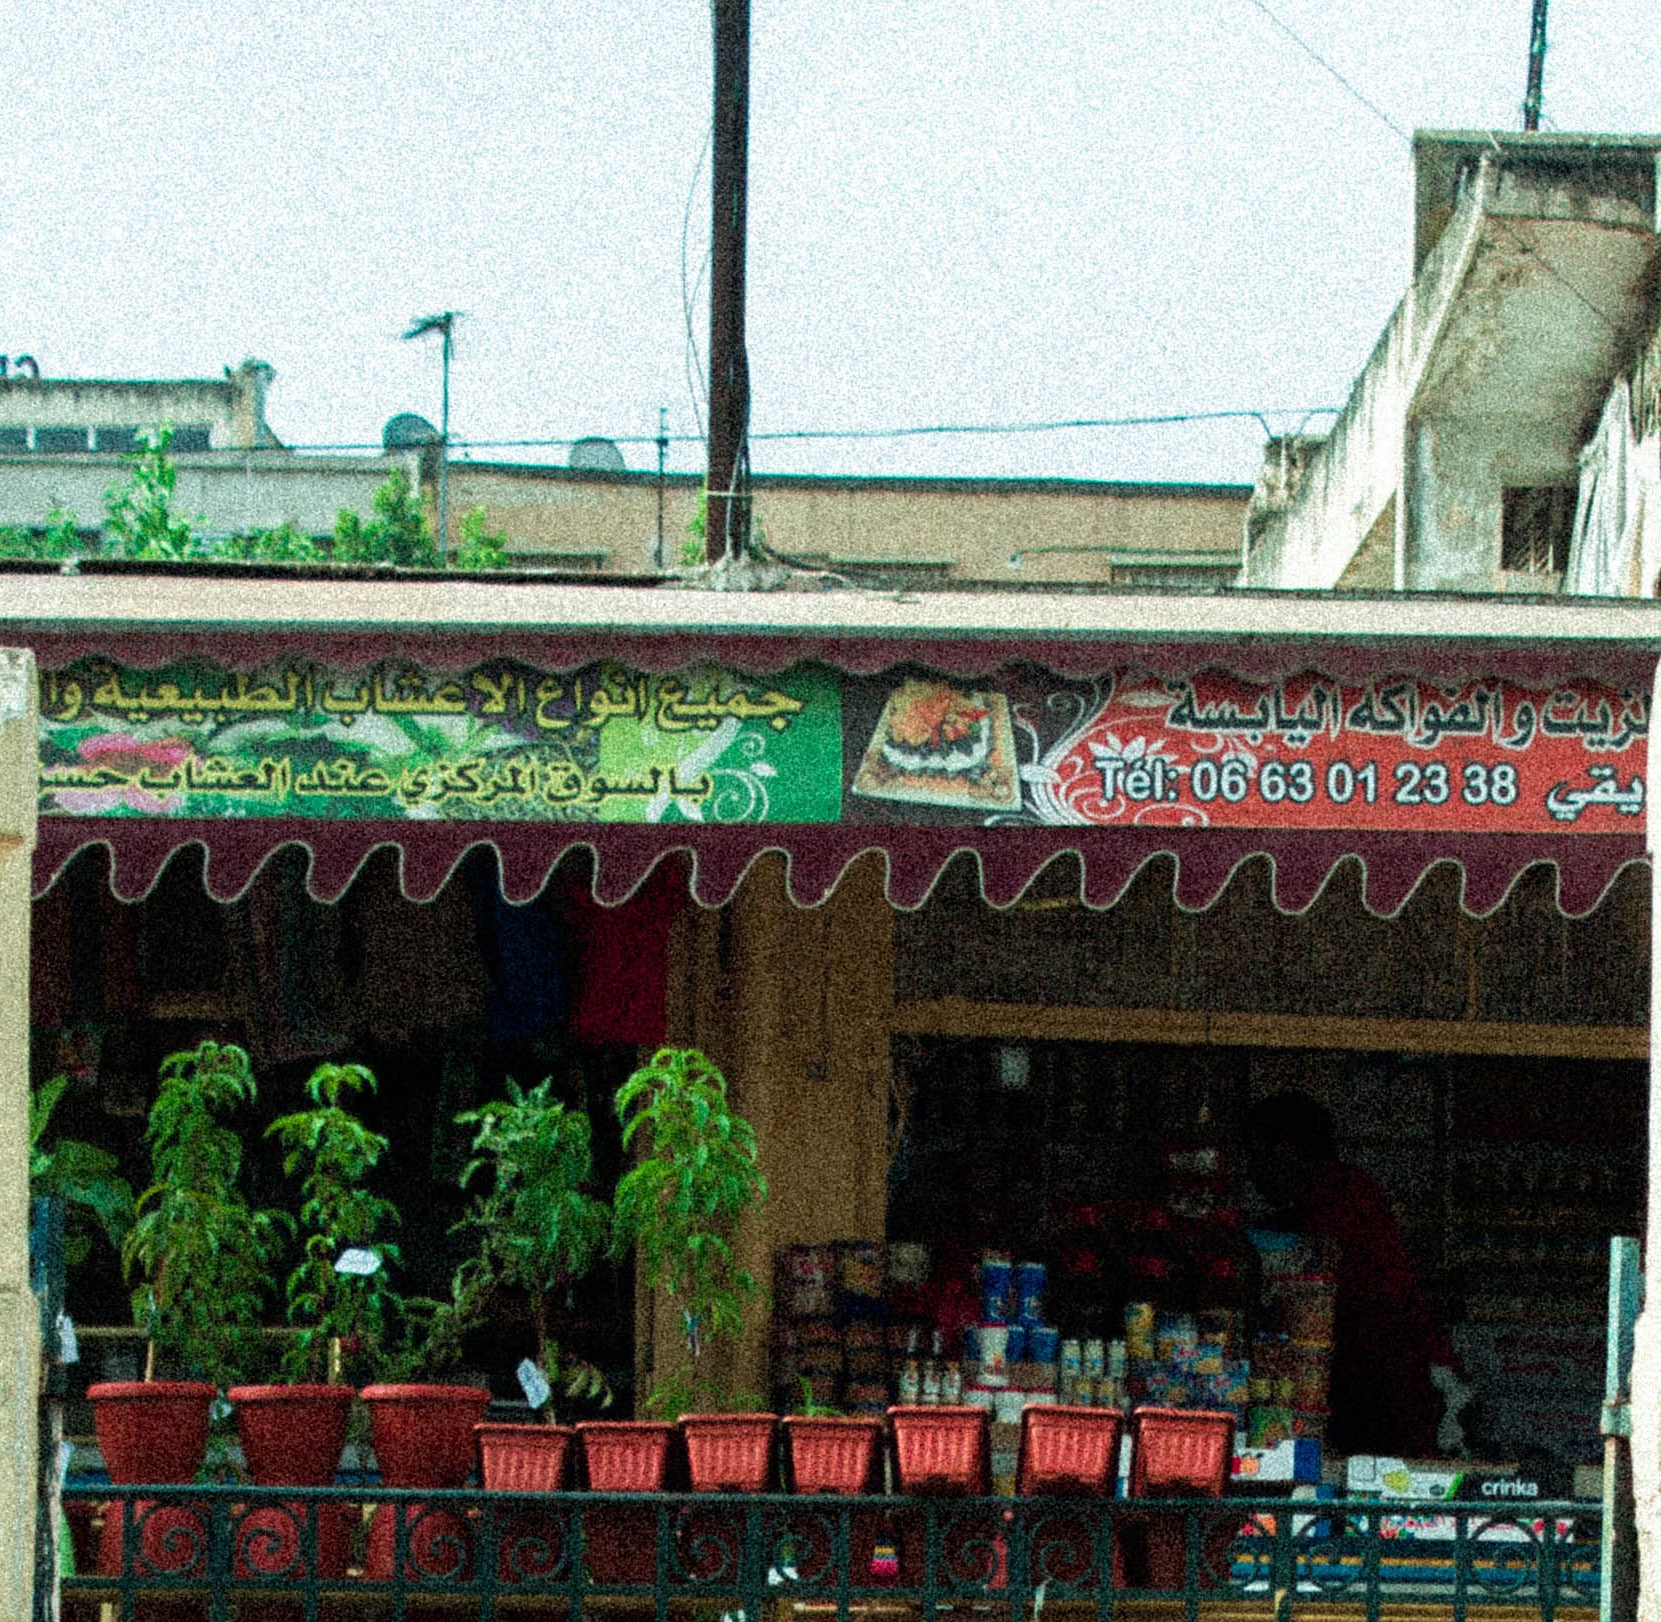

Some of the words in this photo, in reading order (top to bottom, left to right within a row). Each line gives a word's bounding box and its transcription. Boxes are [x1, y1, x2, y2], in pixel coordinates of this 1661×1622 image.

[93, 667, 315, 723] الطبيعية
[536, 674, 647, 729] انواع
[656, 679, 803, 731] جميع
[1166, 680, 1341, 748] اليابسة
[138, 754, 290, 802] العشاب
[296, 759, 393, 796] عند
[398, 756, 540, 807] المركزي
[1094, 757, 1179, 803] Tél:
[1192, 759, 1249, 803] 06
[1259, 760, 1316, 803] 63
[1327, 761, 1378, 804] 01
[1394, 762, 1451, 805] 23
[1463, 763, 1519, 806] 38
[1545, 765, 1646, 822] يقي
[1480, 1476, 1539, 1498] crinka
